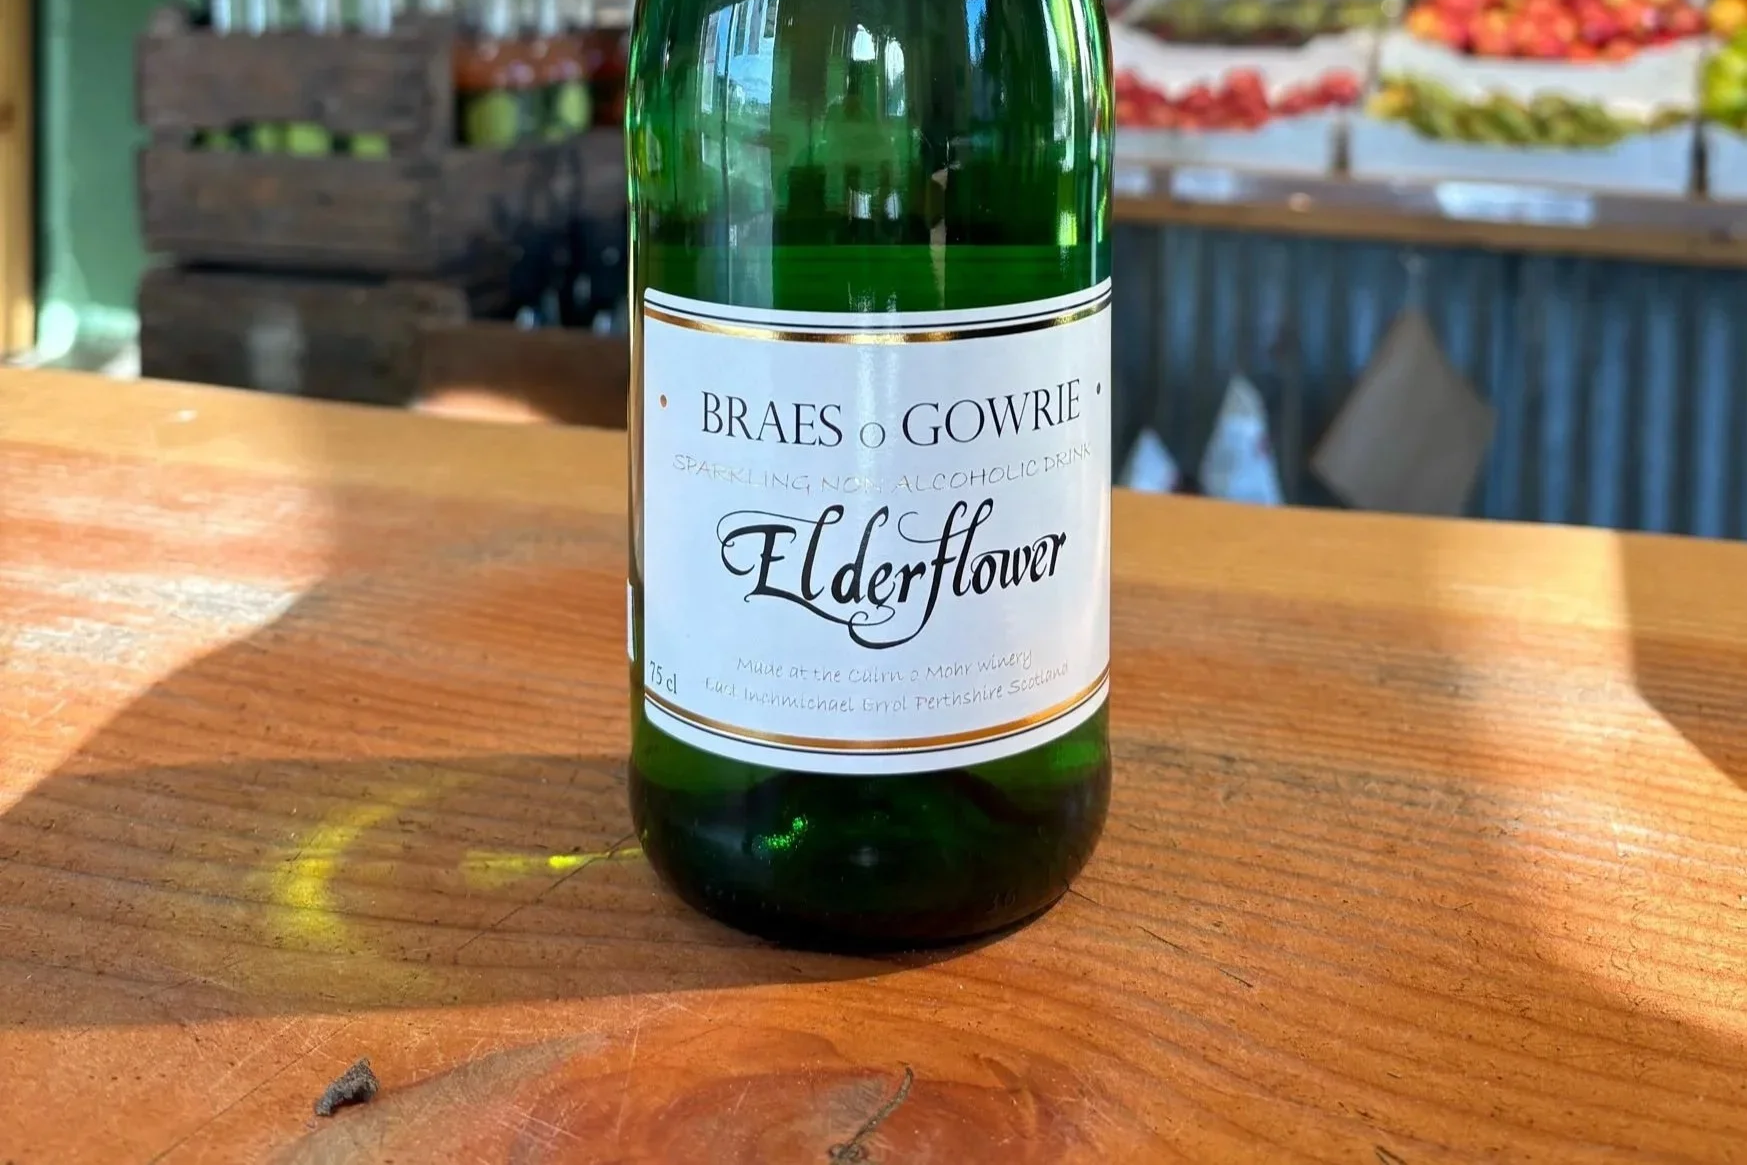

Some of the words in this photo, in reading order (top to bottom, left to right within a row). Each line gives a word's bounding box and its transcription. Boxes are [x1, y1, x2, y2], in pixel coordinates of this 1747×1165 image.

[701, 390, 843, 447] BRAES
[902, 378, 1081, 446] GOWRIE
[672, 454, 810, 495] SPARKLING
[891, 459, 1038, 493] ALCOHOLIC
[1043, 443, 1091, 473] DRINK
[716, 497, 1067, 650] Elderflower
[649, 659, 663, 685] 75
[666, 673, 677, 694] cl
[736, 656, 783, 678] Made
[789, 665, 809, 679] at
[813, 666, 841, 683] the
[847, 667, 904, 684] Cairn
[925, 660, 971, 681] Mohr
[977, 648, 1033, 672] winery
[744, 687, 854, 713] Inchmichael
[862, 696, 908, 714] Errol
[915, 684, 1003, 711] Perthshire
[1007, 659, 1070, 695] Scotland
